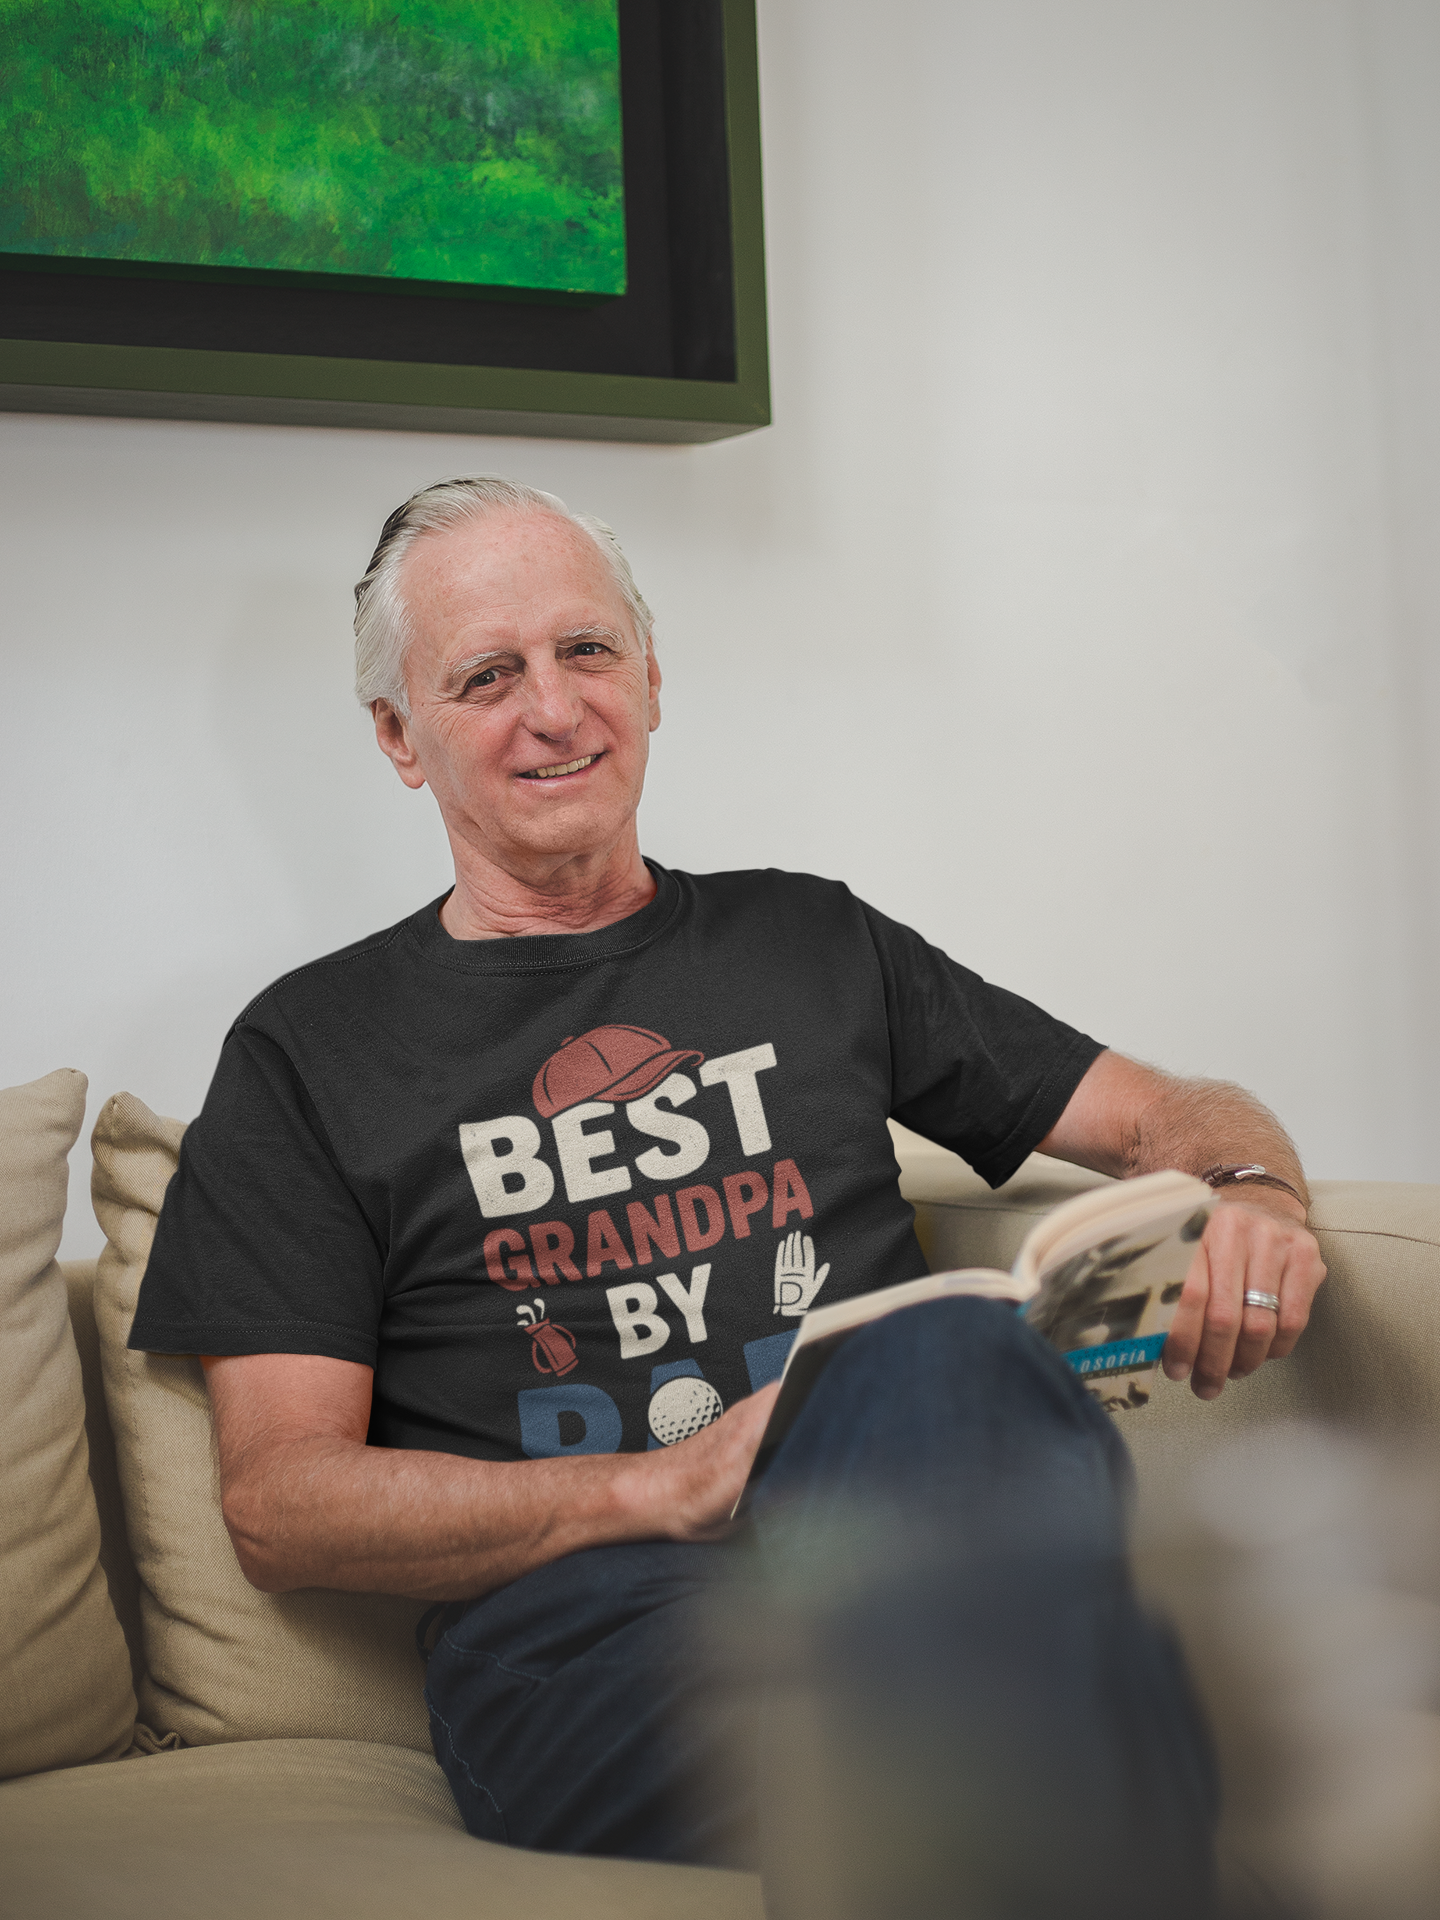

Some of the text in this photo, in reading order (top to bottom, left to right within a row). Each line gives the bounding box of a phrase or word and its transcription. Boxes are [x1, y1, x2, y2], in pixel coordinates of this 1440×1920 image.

[458, 1042, 777, 1218] BEST
[483, 1158, 814, 1291] GRANDPA
[605, 1263, 712, 1360] BY
[1071, 1349, 1146, 1374] OSOFÍA
